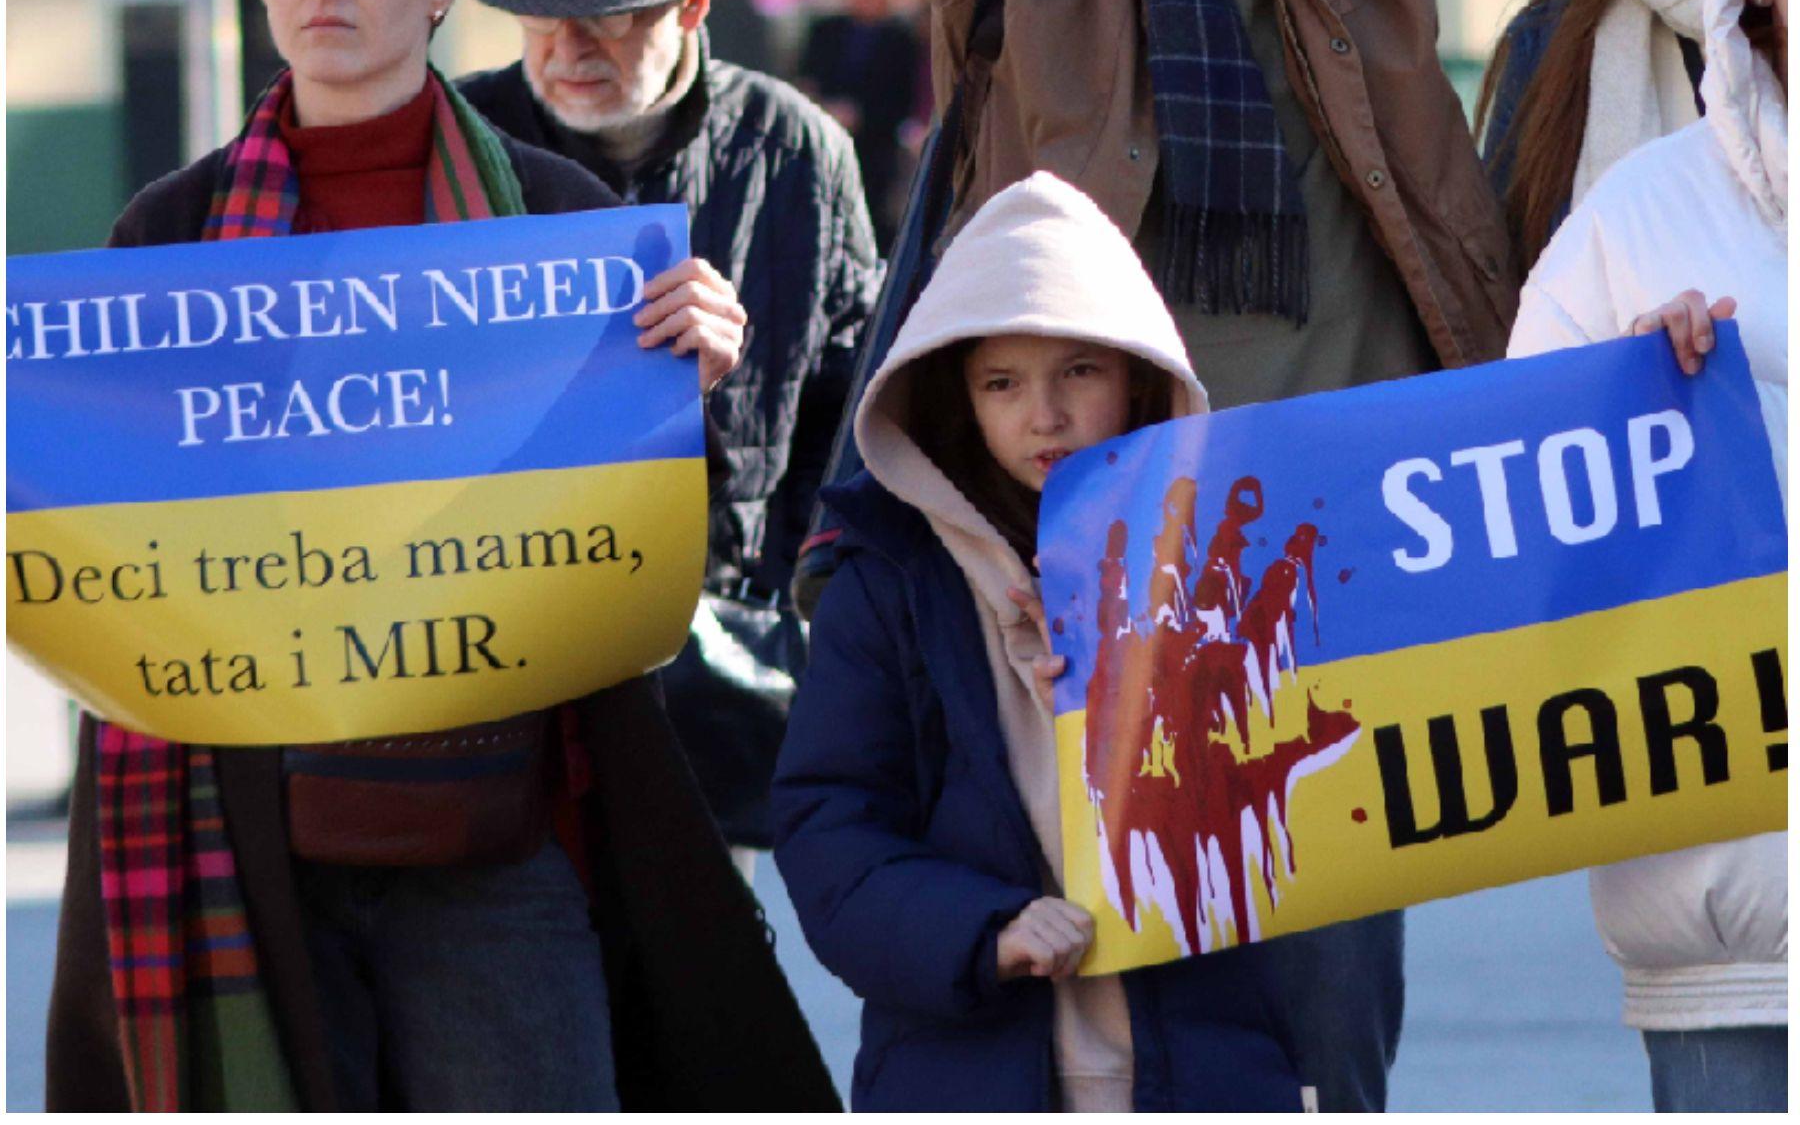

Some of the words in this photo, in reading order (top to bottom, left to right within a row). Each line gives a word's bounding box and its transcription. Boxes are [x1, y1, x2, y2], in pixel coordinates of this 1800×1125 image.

[420, 254, 646, 327] NEED
[176, 368, 455, 447] PEACE!
[1381, 409, 1695, 573] STOP
[8, 538, 168, 605] Deci
[193, 531, 377, 594] treba
[403, 521, 645, 581] mama,
[136, 647, 266, 697] tata
[290, 629, 313, 687] i
[334, 612, 528, 683] MIR.
[1373, 648, 1788, 848] WAR!
